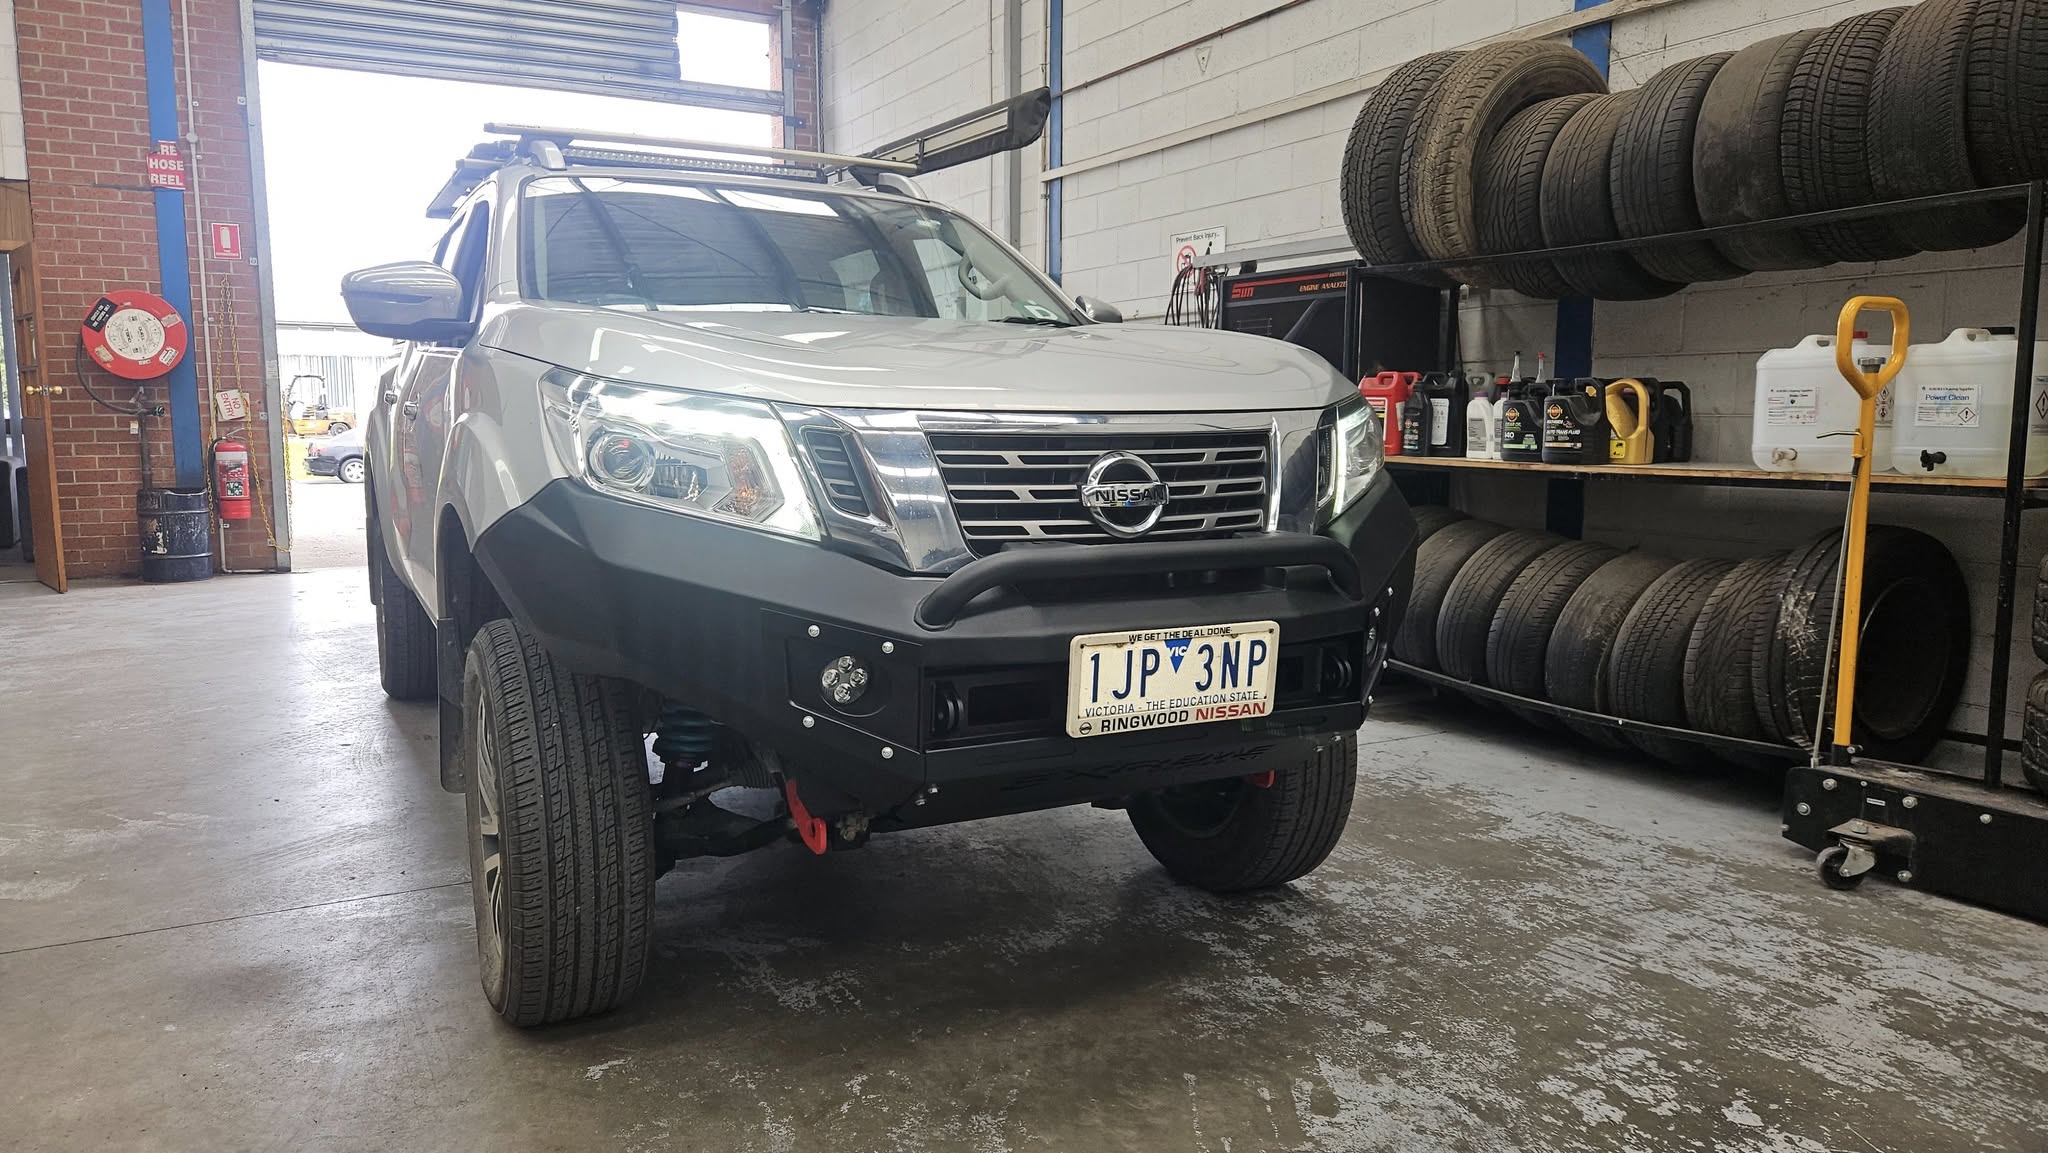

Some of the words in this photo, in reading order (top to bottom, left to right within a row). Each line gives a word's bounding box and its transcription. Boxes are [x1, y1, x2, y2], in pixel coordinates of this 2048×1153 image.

[149, 158, 184, 171] HOSE
[150, 173, 184, 186] REEL
[1299, 282, 1319, 292] ENGINE
[231, 397, 241, 409] NO
[1925, 393, 1947, 401] Power
[1948, 393, 1970, 401] Clean
[220, 392, 235, 417] ENTRY
[1095, 487, 1164, 502] NISSAN
[1128, 634, 1143, 642] WE
[1144, 633, 1161, 641] GET
[1163, 631, 1180, 640] THE
[1182, 629, 1205, 638] DEAL
[1207, 627, 1231, 636] DONE
[1167, 646, 1188, 657] VIC
[1194, 639, 1267, 692] 3NP
[1085, 704, 1135, 718] VICTORIA
[1146, 700, 1166, 711] THE
[1169, 694, 1226, 709] EDUCATION
[1229, 690, 1259, 702] STATE
[1101, 711, 1189, 732] RINGWOOD
[1195, 702, 1266, 721] NISSAN
